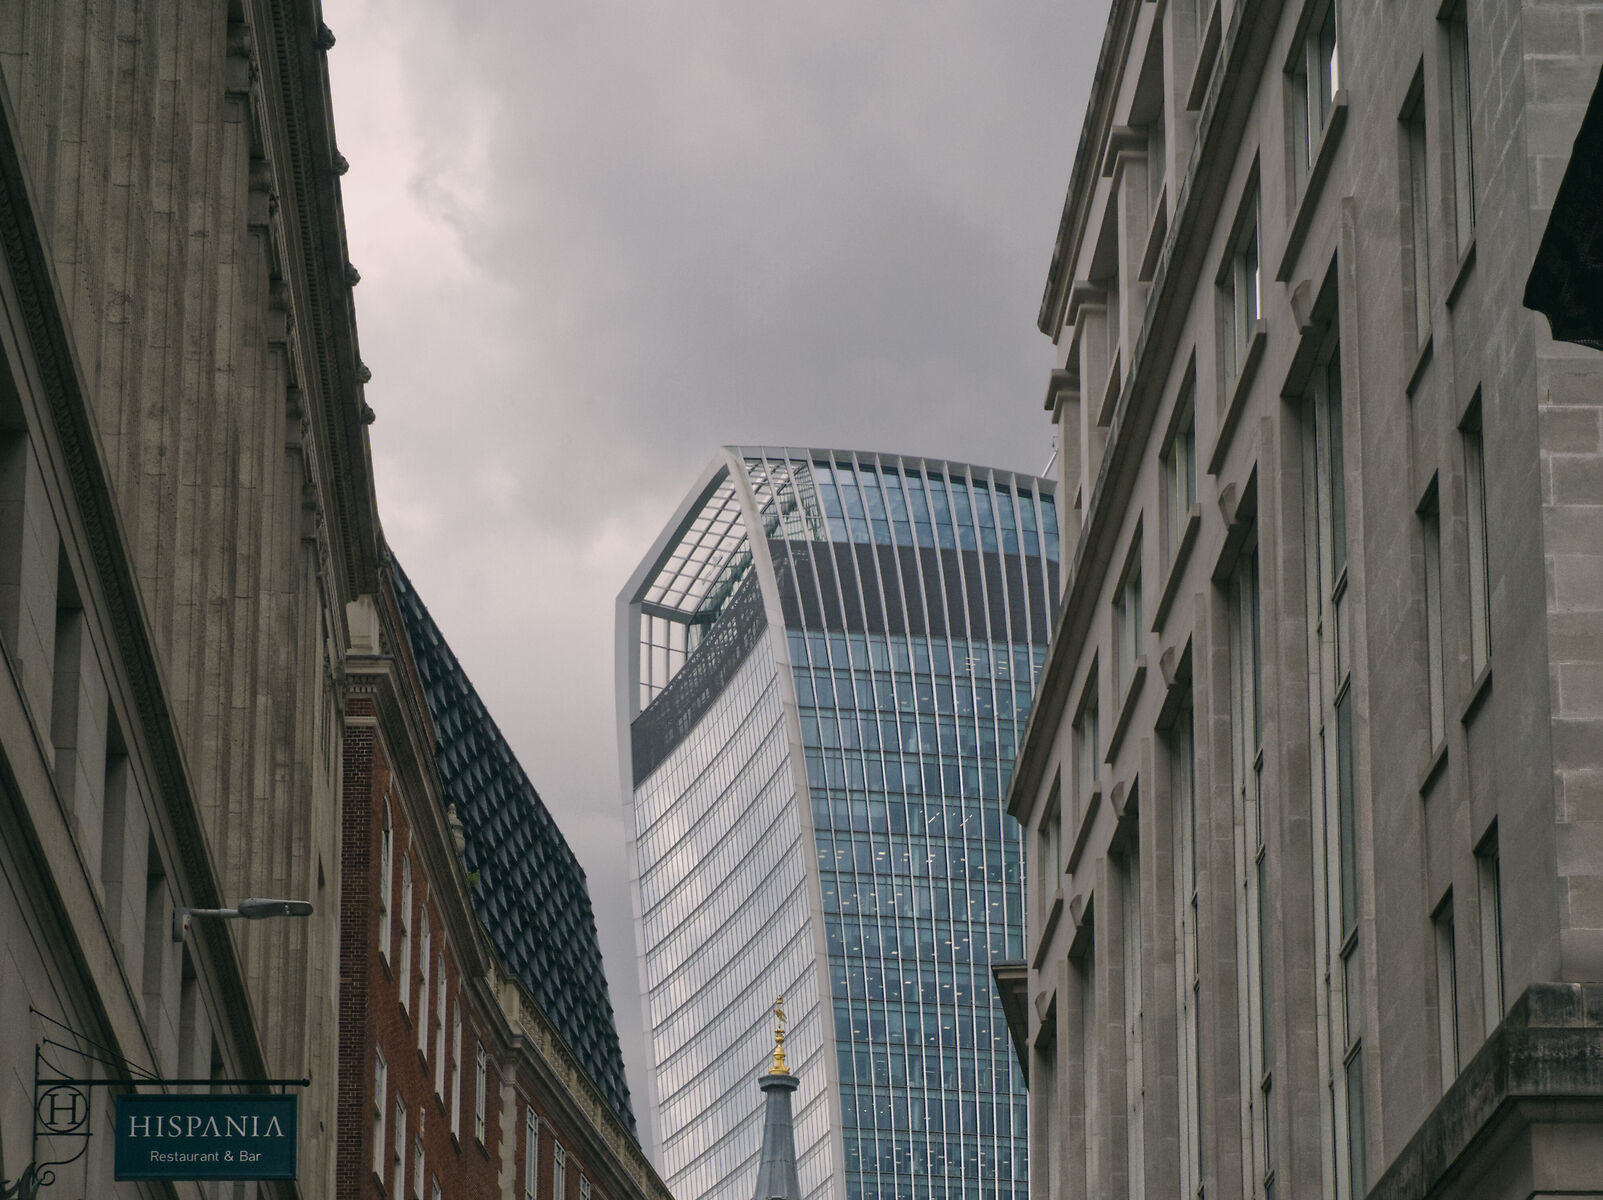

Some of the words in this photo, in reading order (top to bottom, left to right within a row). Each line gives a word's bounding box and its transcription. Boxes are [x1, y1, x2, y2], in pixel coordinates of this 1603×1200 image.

[128, 1115, 285, 1138] HISPANIA
[150, 1150, 219, 1162] Restaurant
[224, 1150, 235, 1162] &
[239, 1151, 263, 1162] Bar
